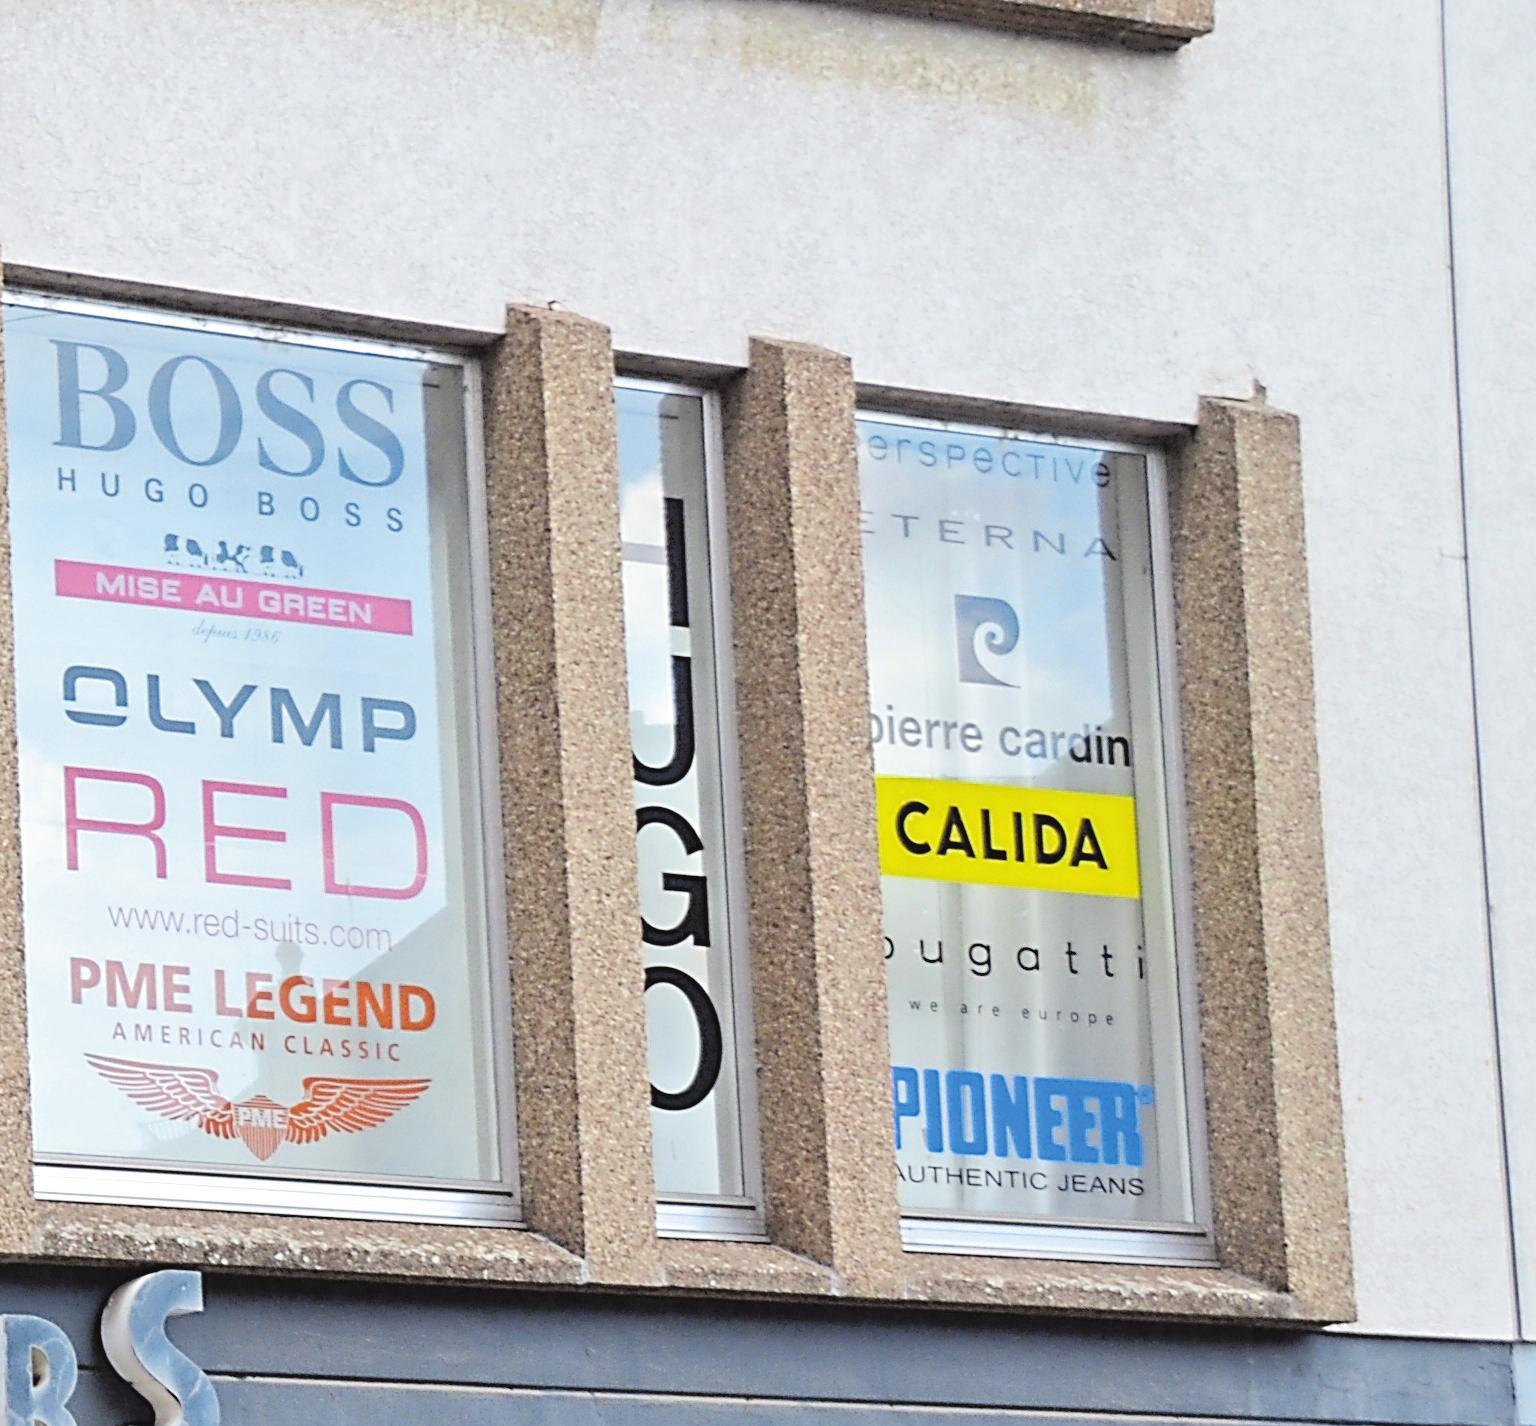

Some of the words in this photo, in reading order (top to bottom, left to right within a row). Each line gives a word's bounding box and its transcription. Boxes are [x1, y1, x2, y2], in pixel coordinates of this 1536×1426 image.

[49, 339, 406, 490] BOSS
[58, 467, 209, 508] HUGO
[258, 497, 404, 533] BOSS
[95, 571, 182, 602] MISE
[196, 584, 243, 609] AU
[257, 591, 373, 625] GREEN
[63, 665, 418, 754] OLYMP
[999, 722, 1131, 769] cardin
[63, 765, 429, 901] RED
[896, 800, 1109, 871] CALIDA
[108, 904, 393, 953] www.red-suits.com
[69, 957, 193, 1014] PME
[215, 968, 437, 1032] LEGEND
[909, 1000, 938, 1012] we
[960, 1003, 1000, 1017] are
[1022, 1008, 1116, 1026] europe
[112, 1022, 266, 1052] AMERICAN
[285, 1035, 403, 1062] CLASSIC
[1057, 1174, 1145, 1197] JEANS
